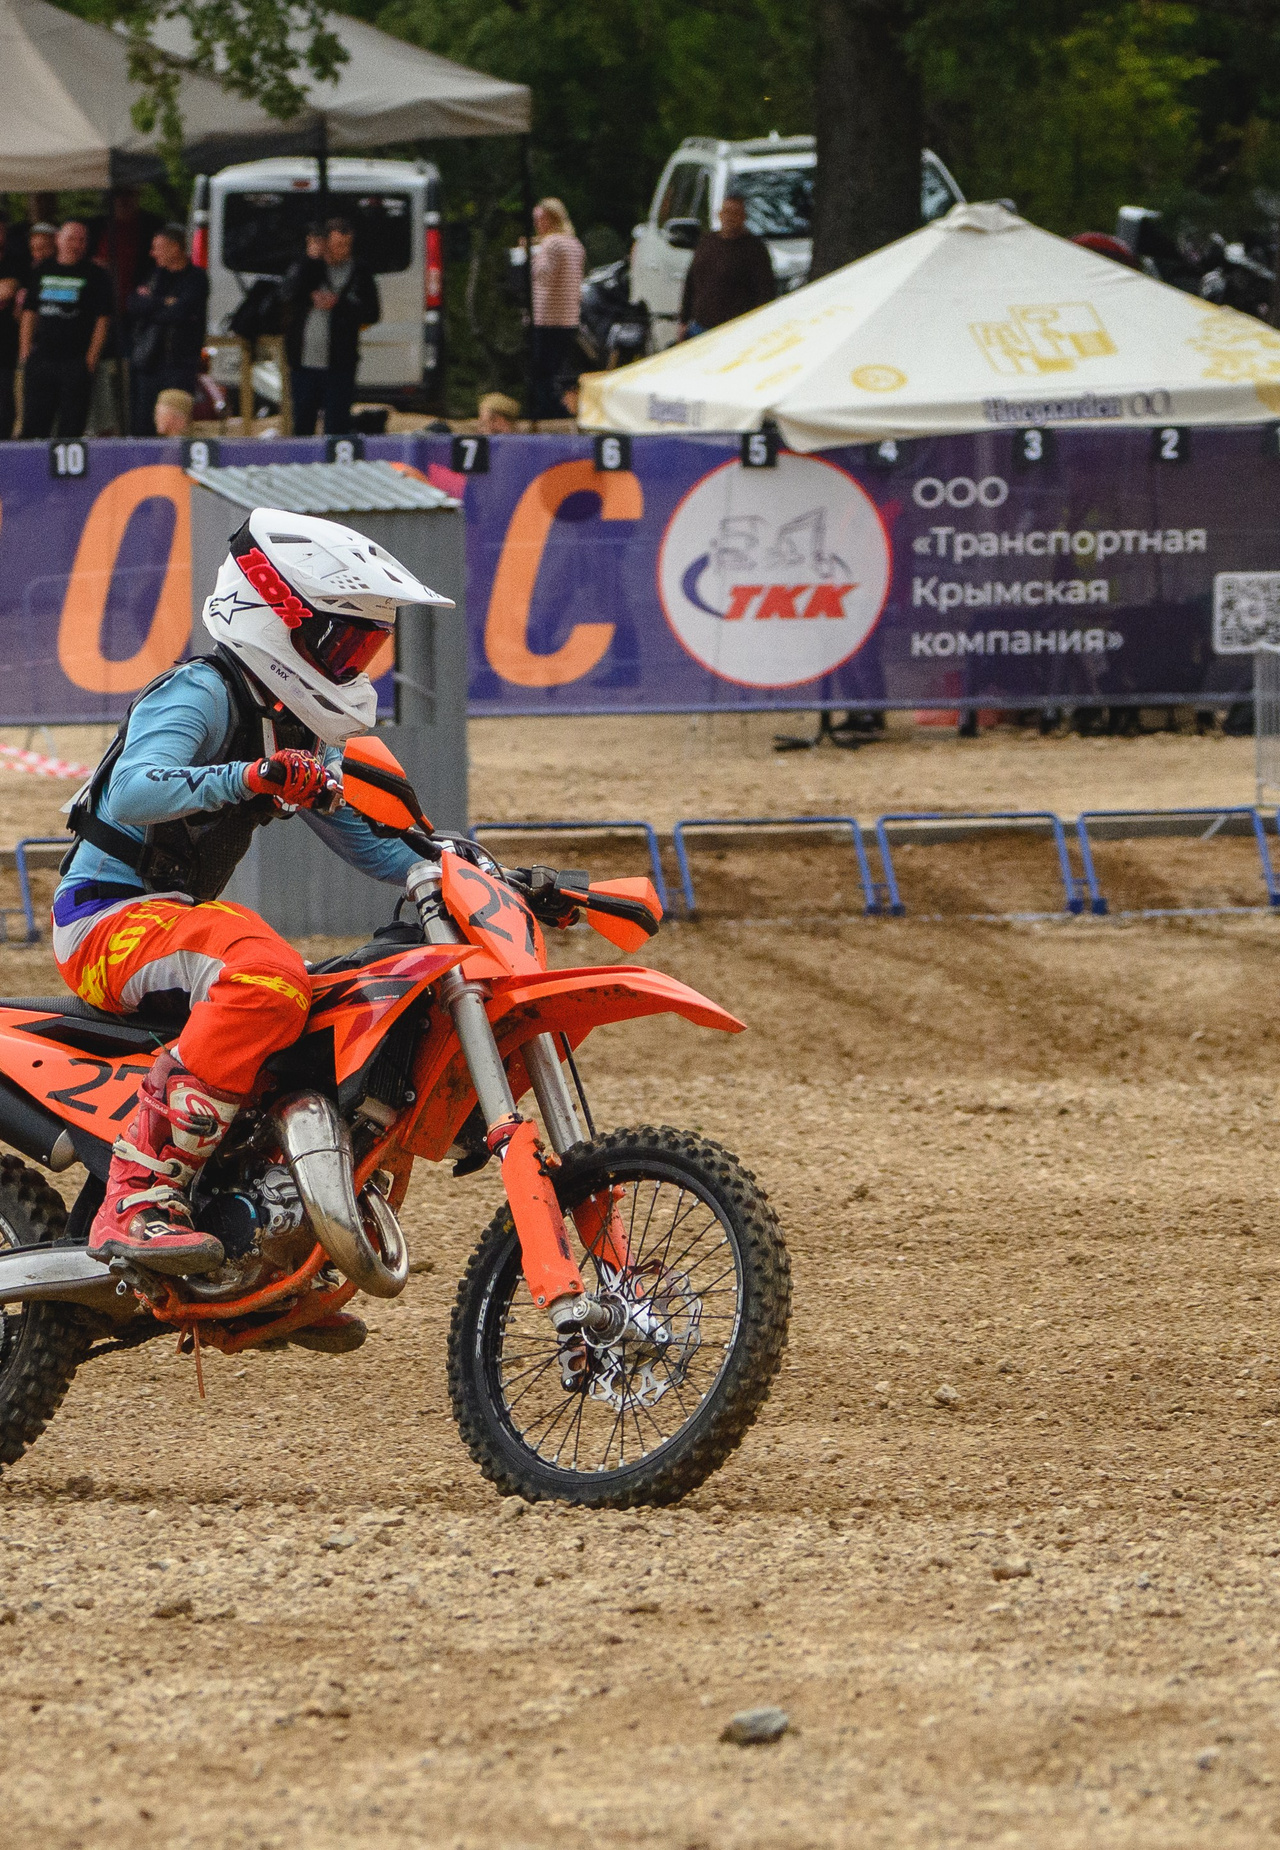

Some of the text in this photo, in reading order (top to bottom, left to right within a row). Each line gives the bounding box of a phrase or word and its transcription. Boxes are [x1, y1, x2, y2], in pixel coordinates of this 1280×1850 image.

[55, 444, 83, 473] 10
[190, 441, 209, 472] 9
[335, 440, 354, 463] 8
[459, 439, 478, 468] 7
[602, 438, 621, 468] 6
[748, 435, 767, 464] 5
[879, 441, 898, 461] 4
[1023, 429, 1043, 460] 3
[1160, 428, 1179, 459] 2
[913, 476, 1008, 508] ООО
[913, 526, 1207, 563] «Транспортная
[236, 547, 314, 629] 100%
[722, 584, 859, 620] ТКК
[913, 576, 1109, 613] Крымская
[912, 628, 1124, 657] компания»
[45, 1057, 151, 1120] 27
